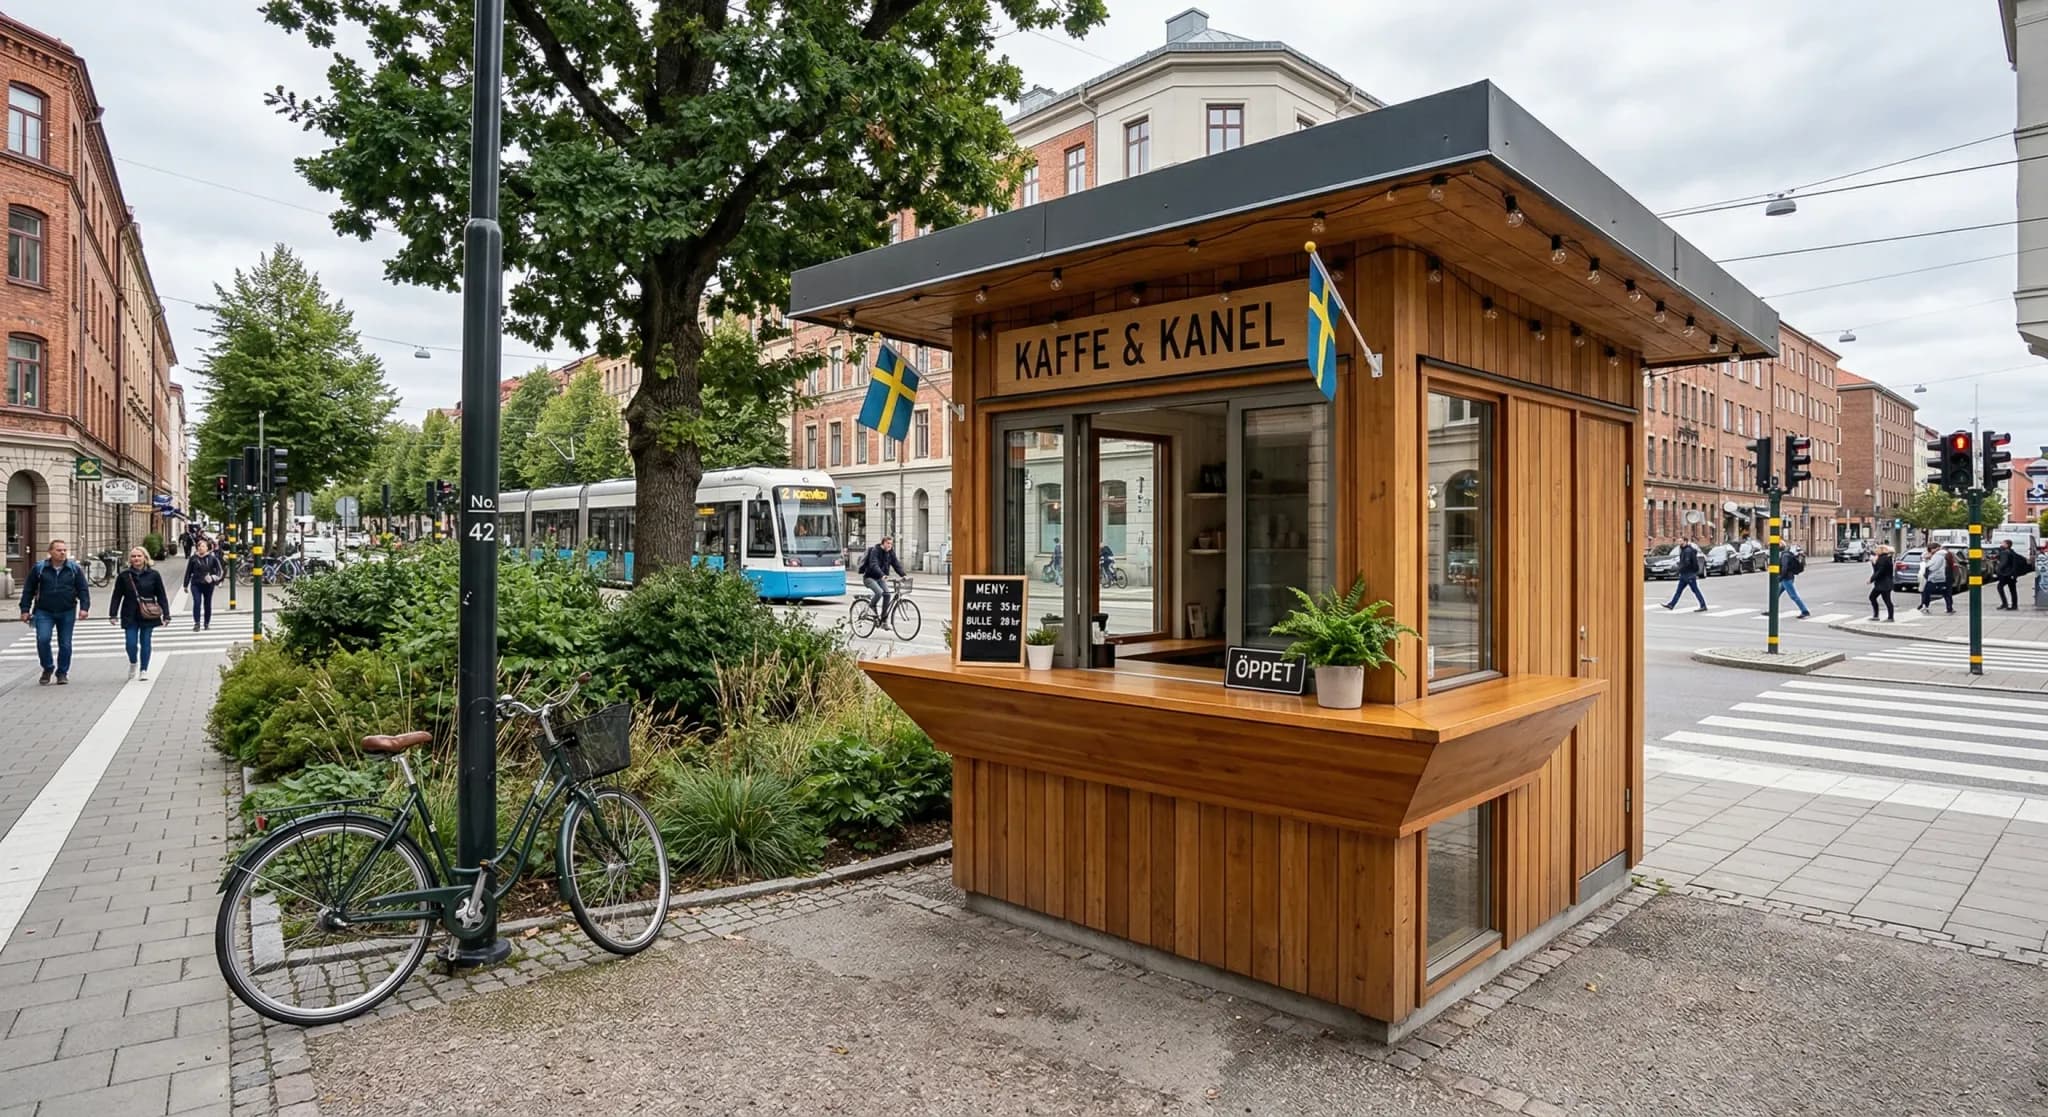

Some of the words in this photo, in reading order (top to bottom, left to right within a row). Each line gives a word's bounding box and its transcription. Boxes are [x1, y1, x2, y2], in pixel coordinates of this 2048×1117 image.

[1015, 327, 1110, 381] KAFFE
[1122, 321, 1146, 367] &
[1160, 301, 1286, 362] KANEL
[471, 494, 495, 509] No.
[469, 522, 495, 541] 42
[976, 583, 1009, 594] MENY:
[966, 601, 992, 611] KAFFE
[1000, 601, 1011, 611] 35
[966, 616, 993, 626] BULLE
[1235, 654, 1296, 683] ÖPPET
